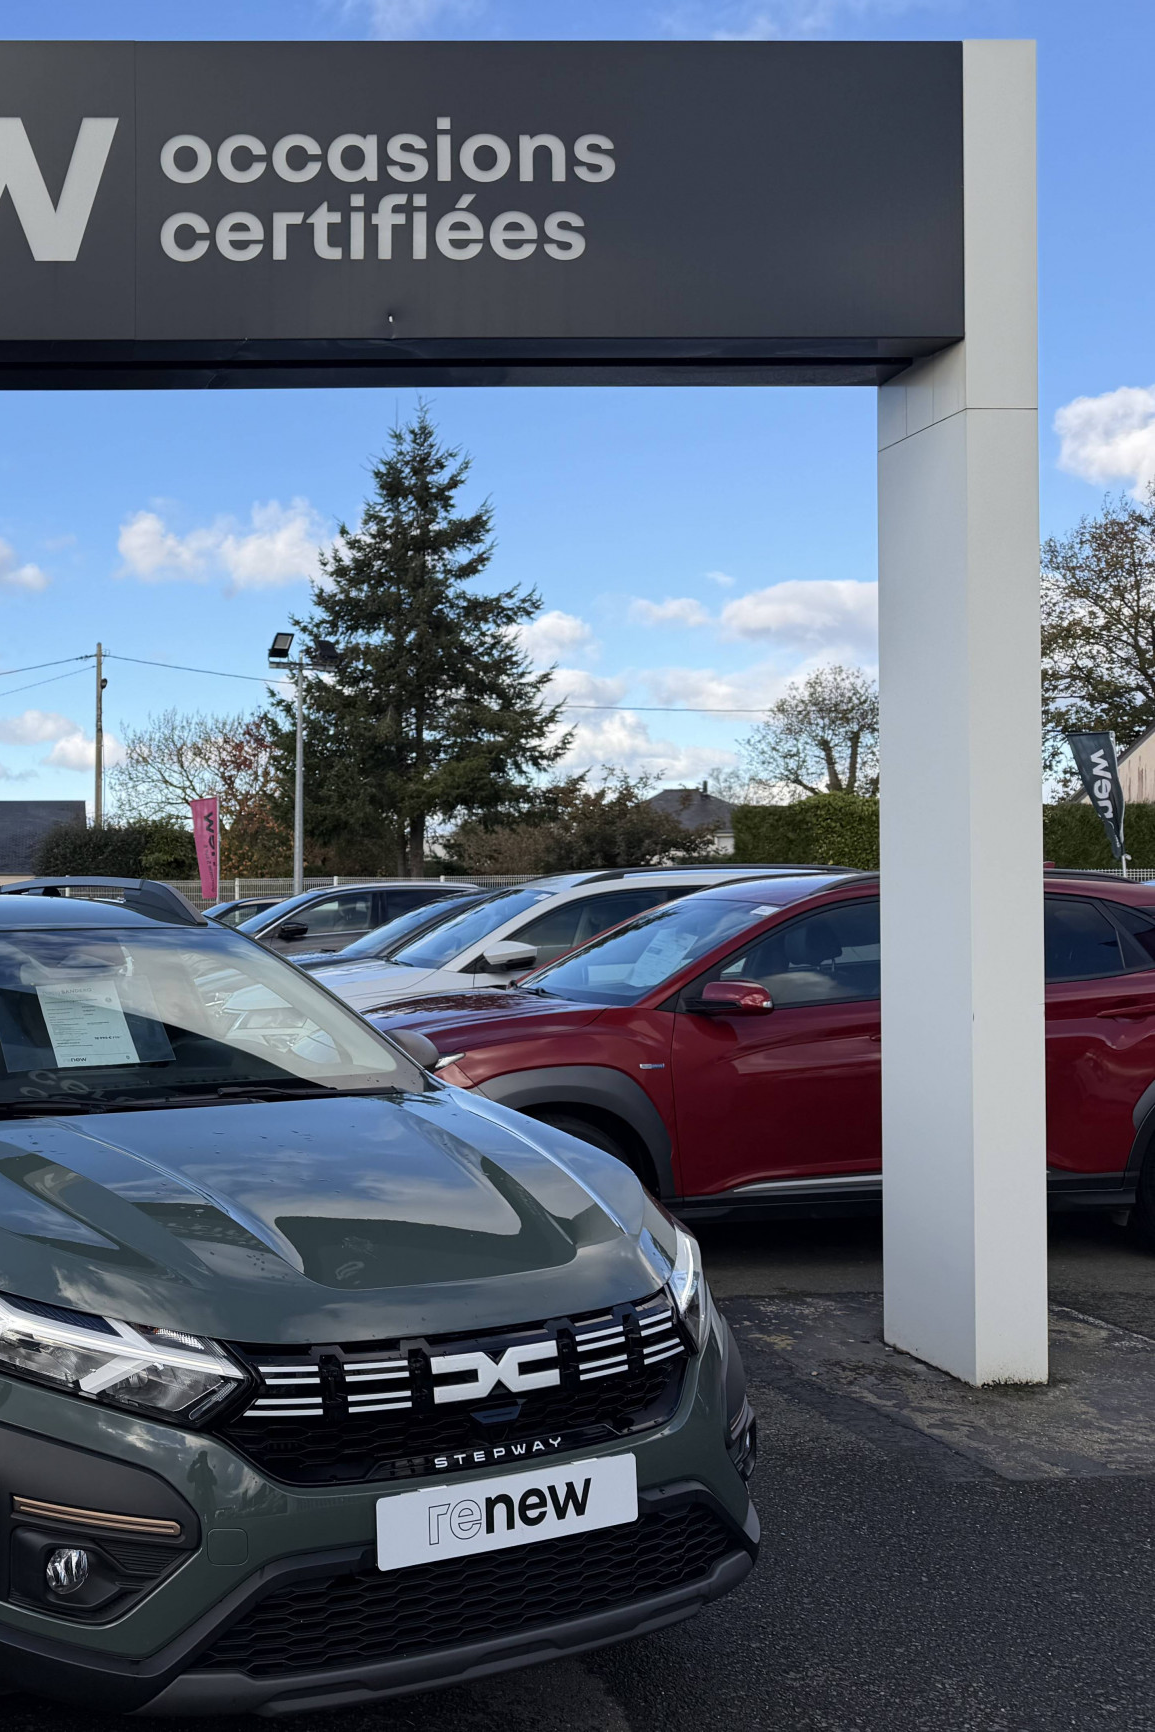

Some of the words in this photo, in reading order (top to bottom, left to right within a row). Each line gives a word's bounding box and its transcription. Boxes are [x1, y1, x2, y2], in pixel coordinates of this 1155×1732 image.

[160, 116, 616, 184] occasions
[160, 193, 586, 262] certifiées
[434, 1436, 562, 1469] STEPWAY
[428, 1477, 592, 1545] renew
